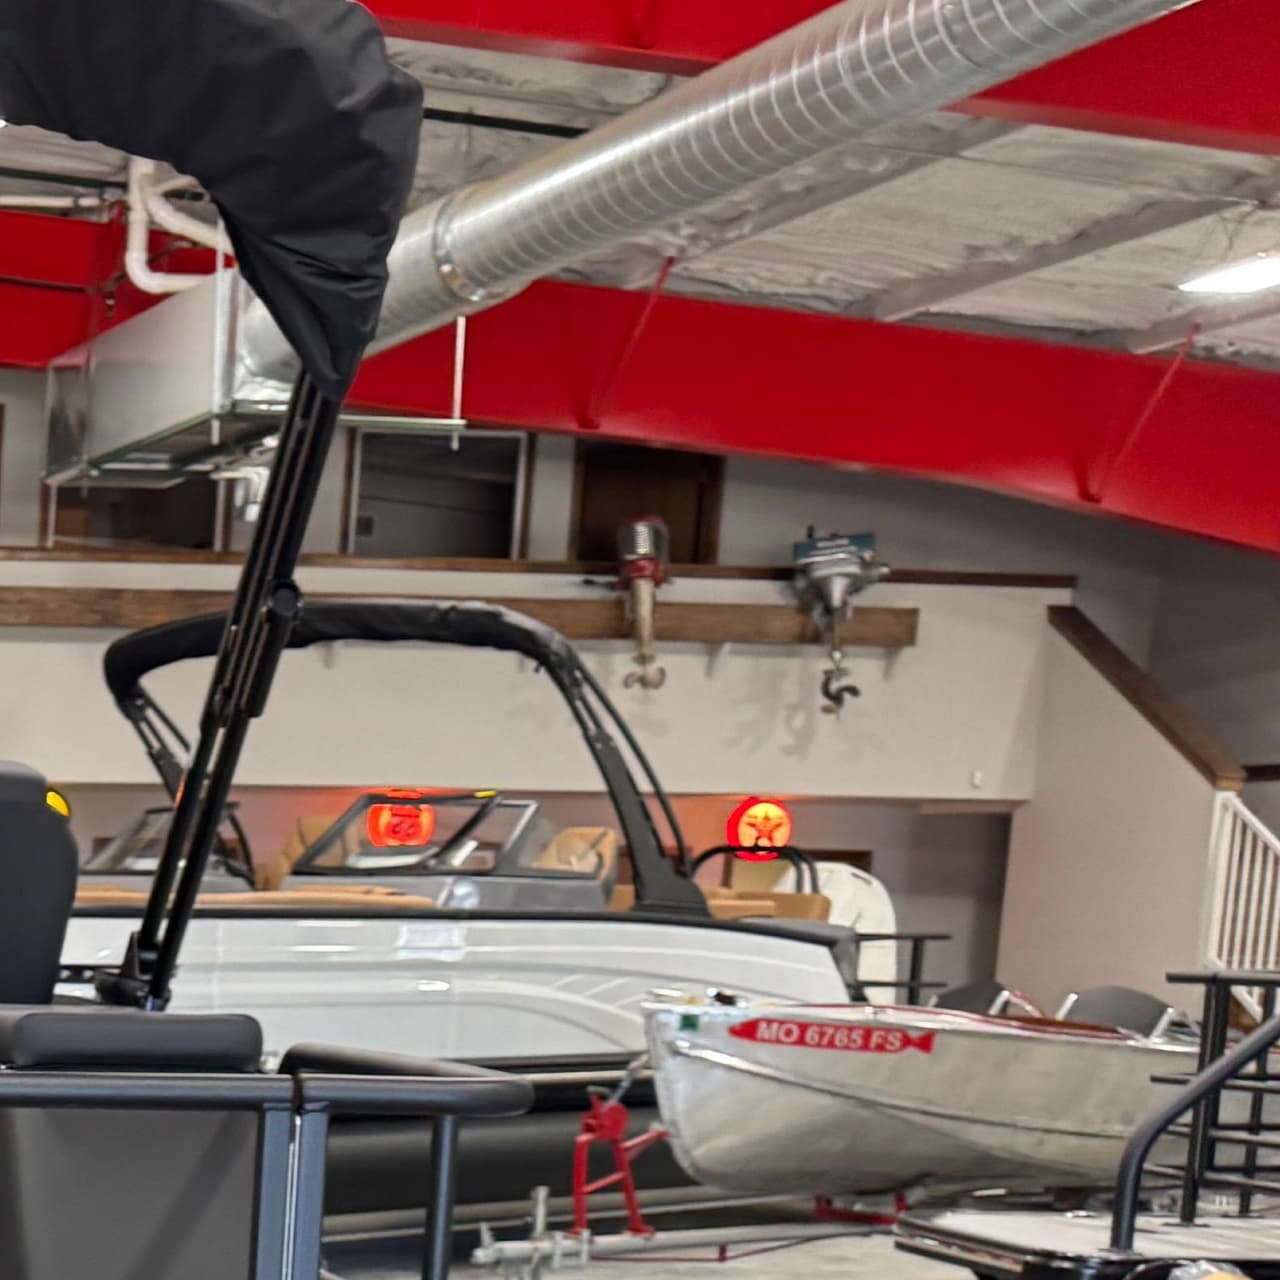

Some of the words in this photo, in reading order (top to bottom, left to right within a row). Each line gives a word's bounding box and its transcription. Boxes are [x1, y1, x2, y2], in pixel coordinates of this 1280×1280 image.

[755, 1021, 800, 1043] MO
[804, 1025, 864, 1049] 6765
[869, 1031, 903, 1050] FS
